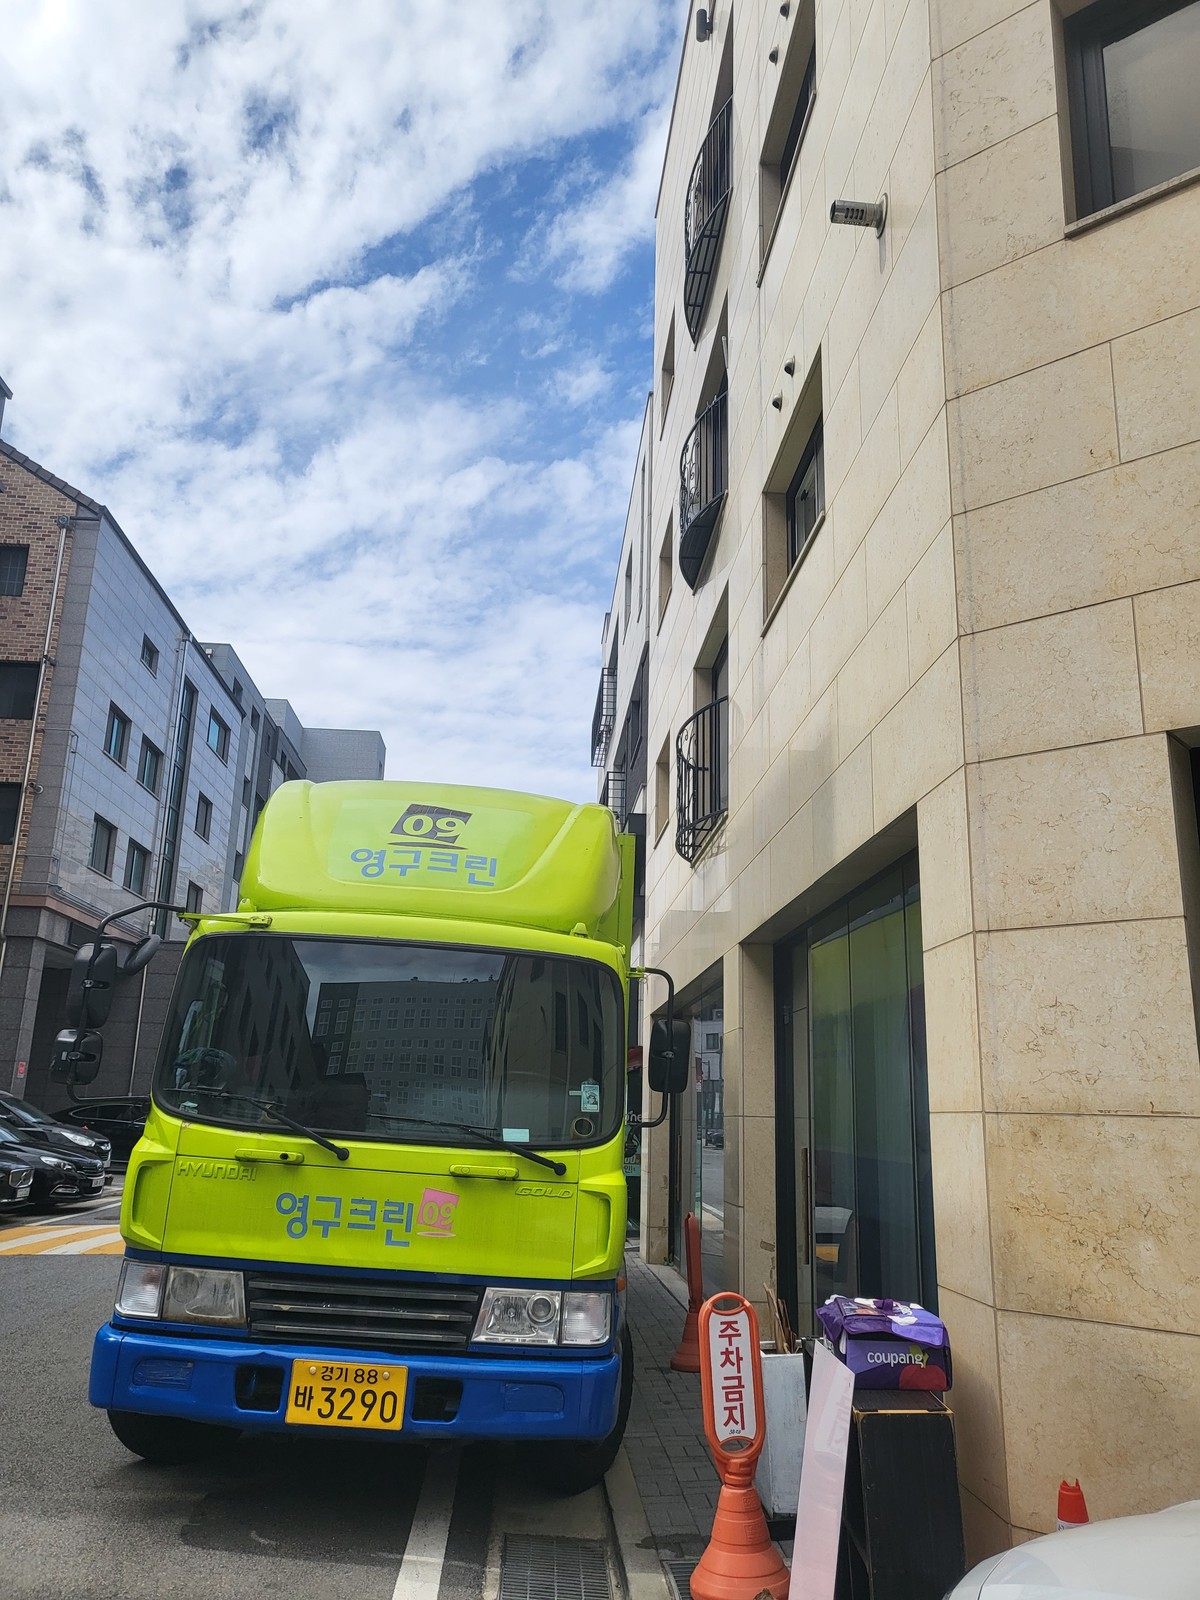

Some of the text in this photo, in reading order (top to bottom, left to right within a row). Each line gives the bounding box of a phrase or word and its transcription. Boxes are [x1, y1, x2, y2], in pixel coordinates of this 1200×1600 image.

[402, 814, 467, 839] 09
[350, 848, 498, 887] 영구크린
[176, 1161, 258, 1181] HYUNDAI
[515, 1187, 574, 1199] GOLD
[276, 1192, 457, 1247] 영구크린 09
[867, 1351, 925, 1369] coupang
[321, 1366, 378, 1384] 경기 88
[718, 1320, 746, 1431] 주차금지
